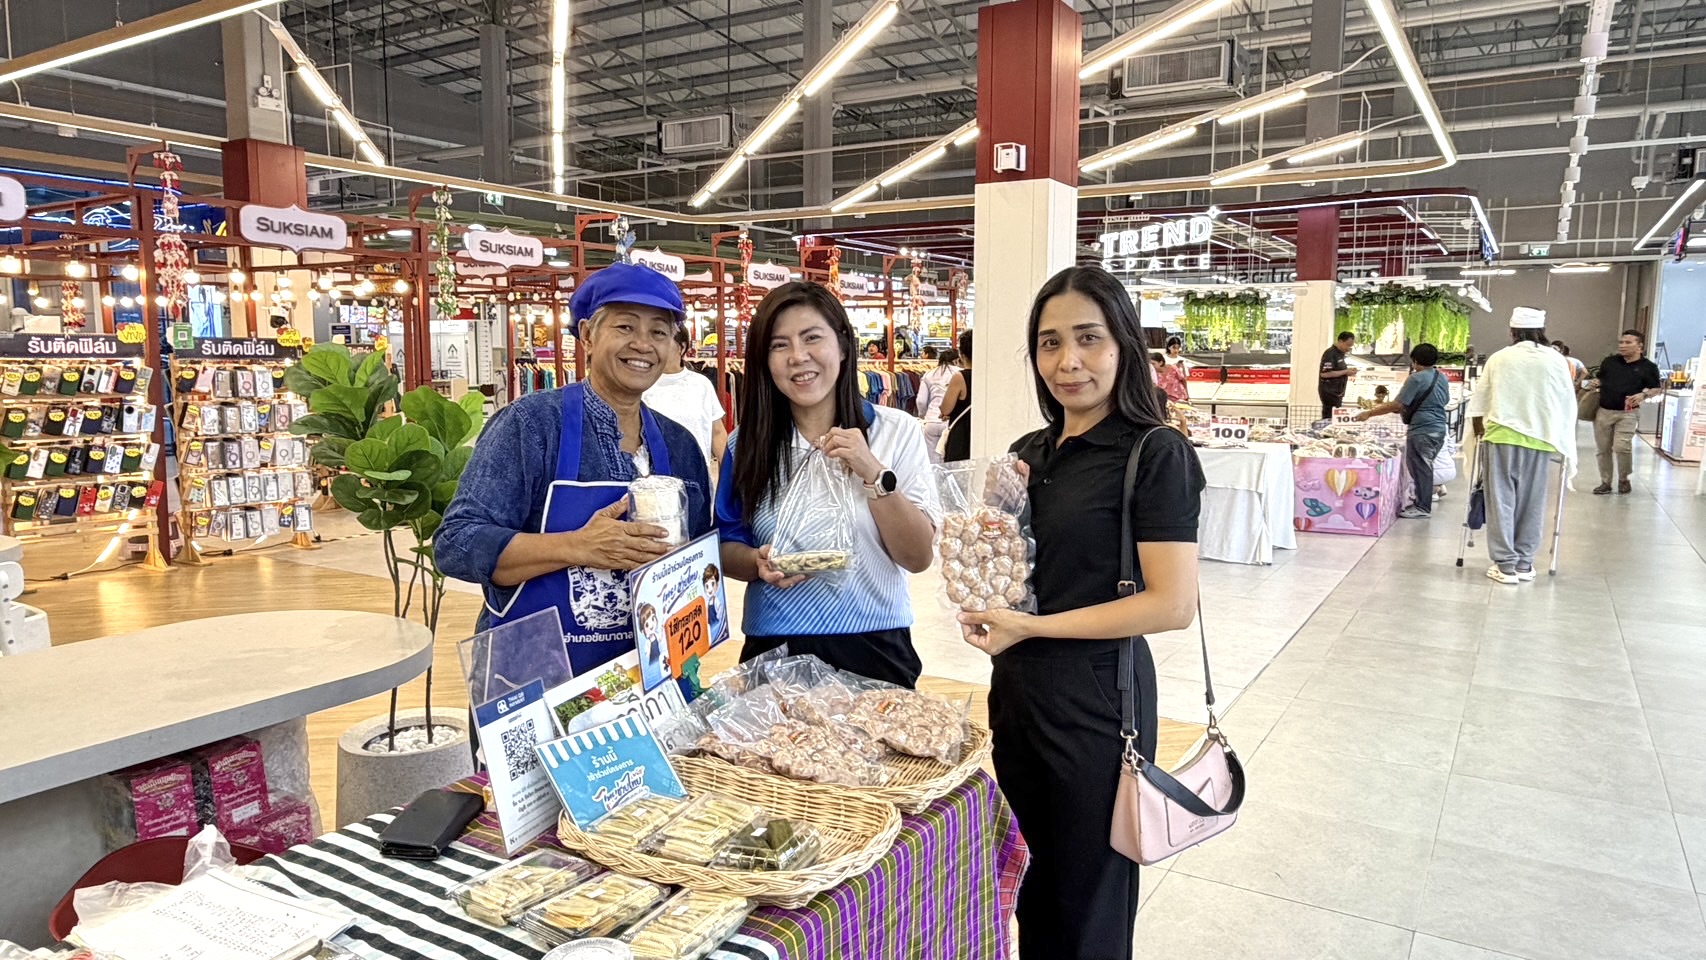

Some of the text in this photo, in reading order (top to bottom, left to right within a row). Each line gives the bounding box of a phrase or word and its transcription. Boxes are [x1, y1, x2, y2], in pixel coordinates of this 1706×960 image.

[256, 216, 334, 241] SUKSIAM
[1099, 215, 1211, 259] TREND
[479, 239, 534, 258] SUKSIAM
[753, 270, 785, 282] SUKSIAM
[27, 336, 117, 355] รับติดฟิล์ม
[201, 340, 275, 356] รับติดฟิล์ม
[1212, 427, 1246, 439] 100
[678, 620, 702, 656] 120
[590, 745, 619, 769] ร้านนี้
[586, 759, 635, 782] เข้าร่วมโครงการ
